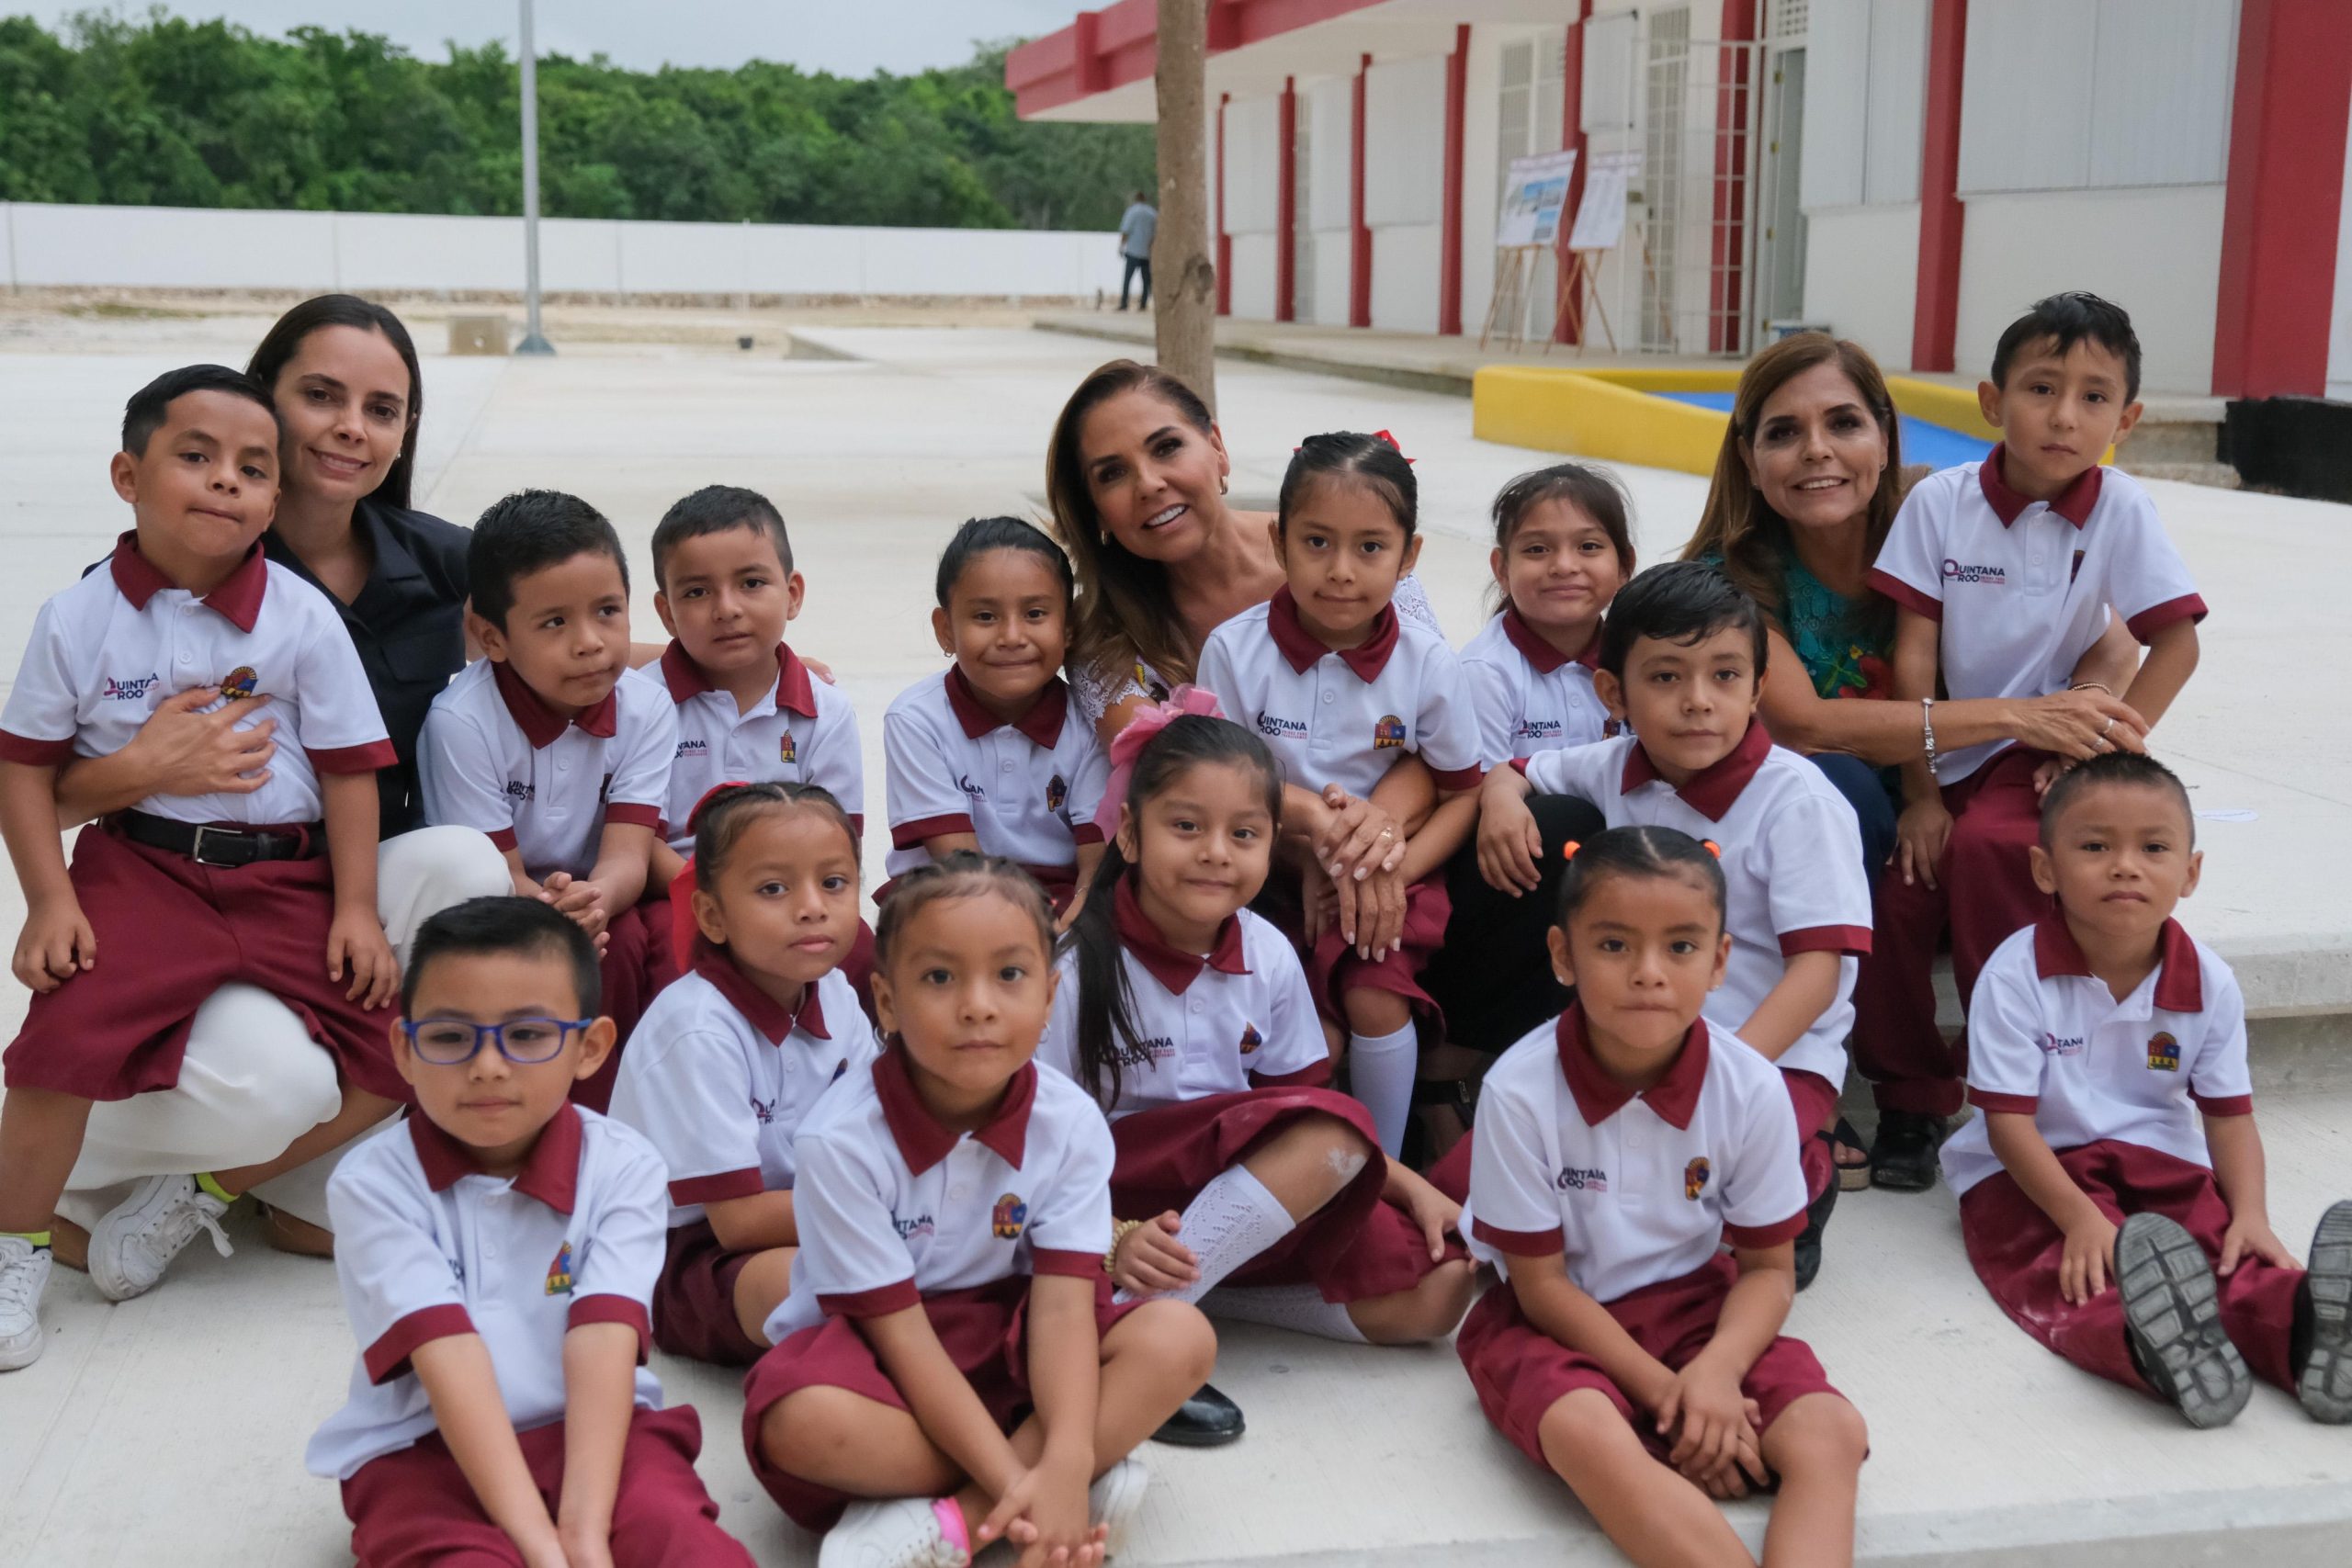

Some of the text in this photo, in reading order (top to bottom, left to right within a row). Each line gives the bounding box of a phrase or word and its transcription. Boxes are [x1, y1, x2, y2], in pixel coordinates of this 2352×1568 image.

[1943, 558, 2005, 577] QUINTANA
[1957, 574, 1980, 582] ROO
[117, 689, 143, 700] ROO
